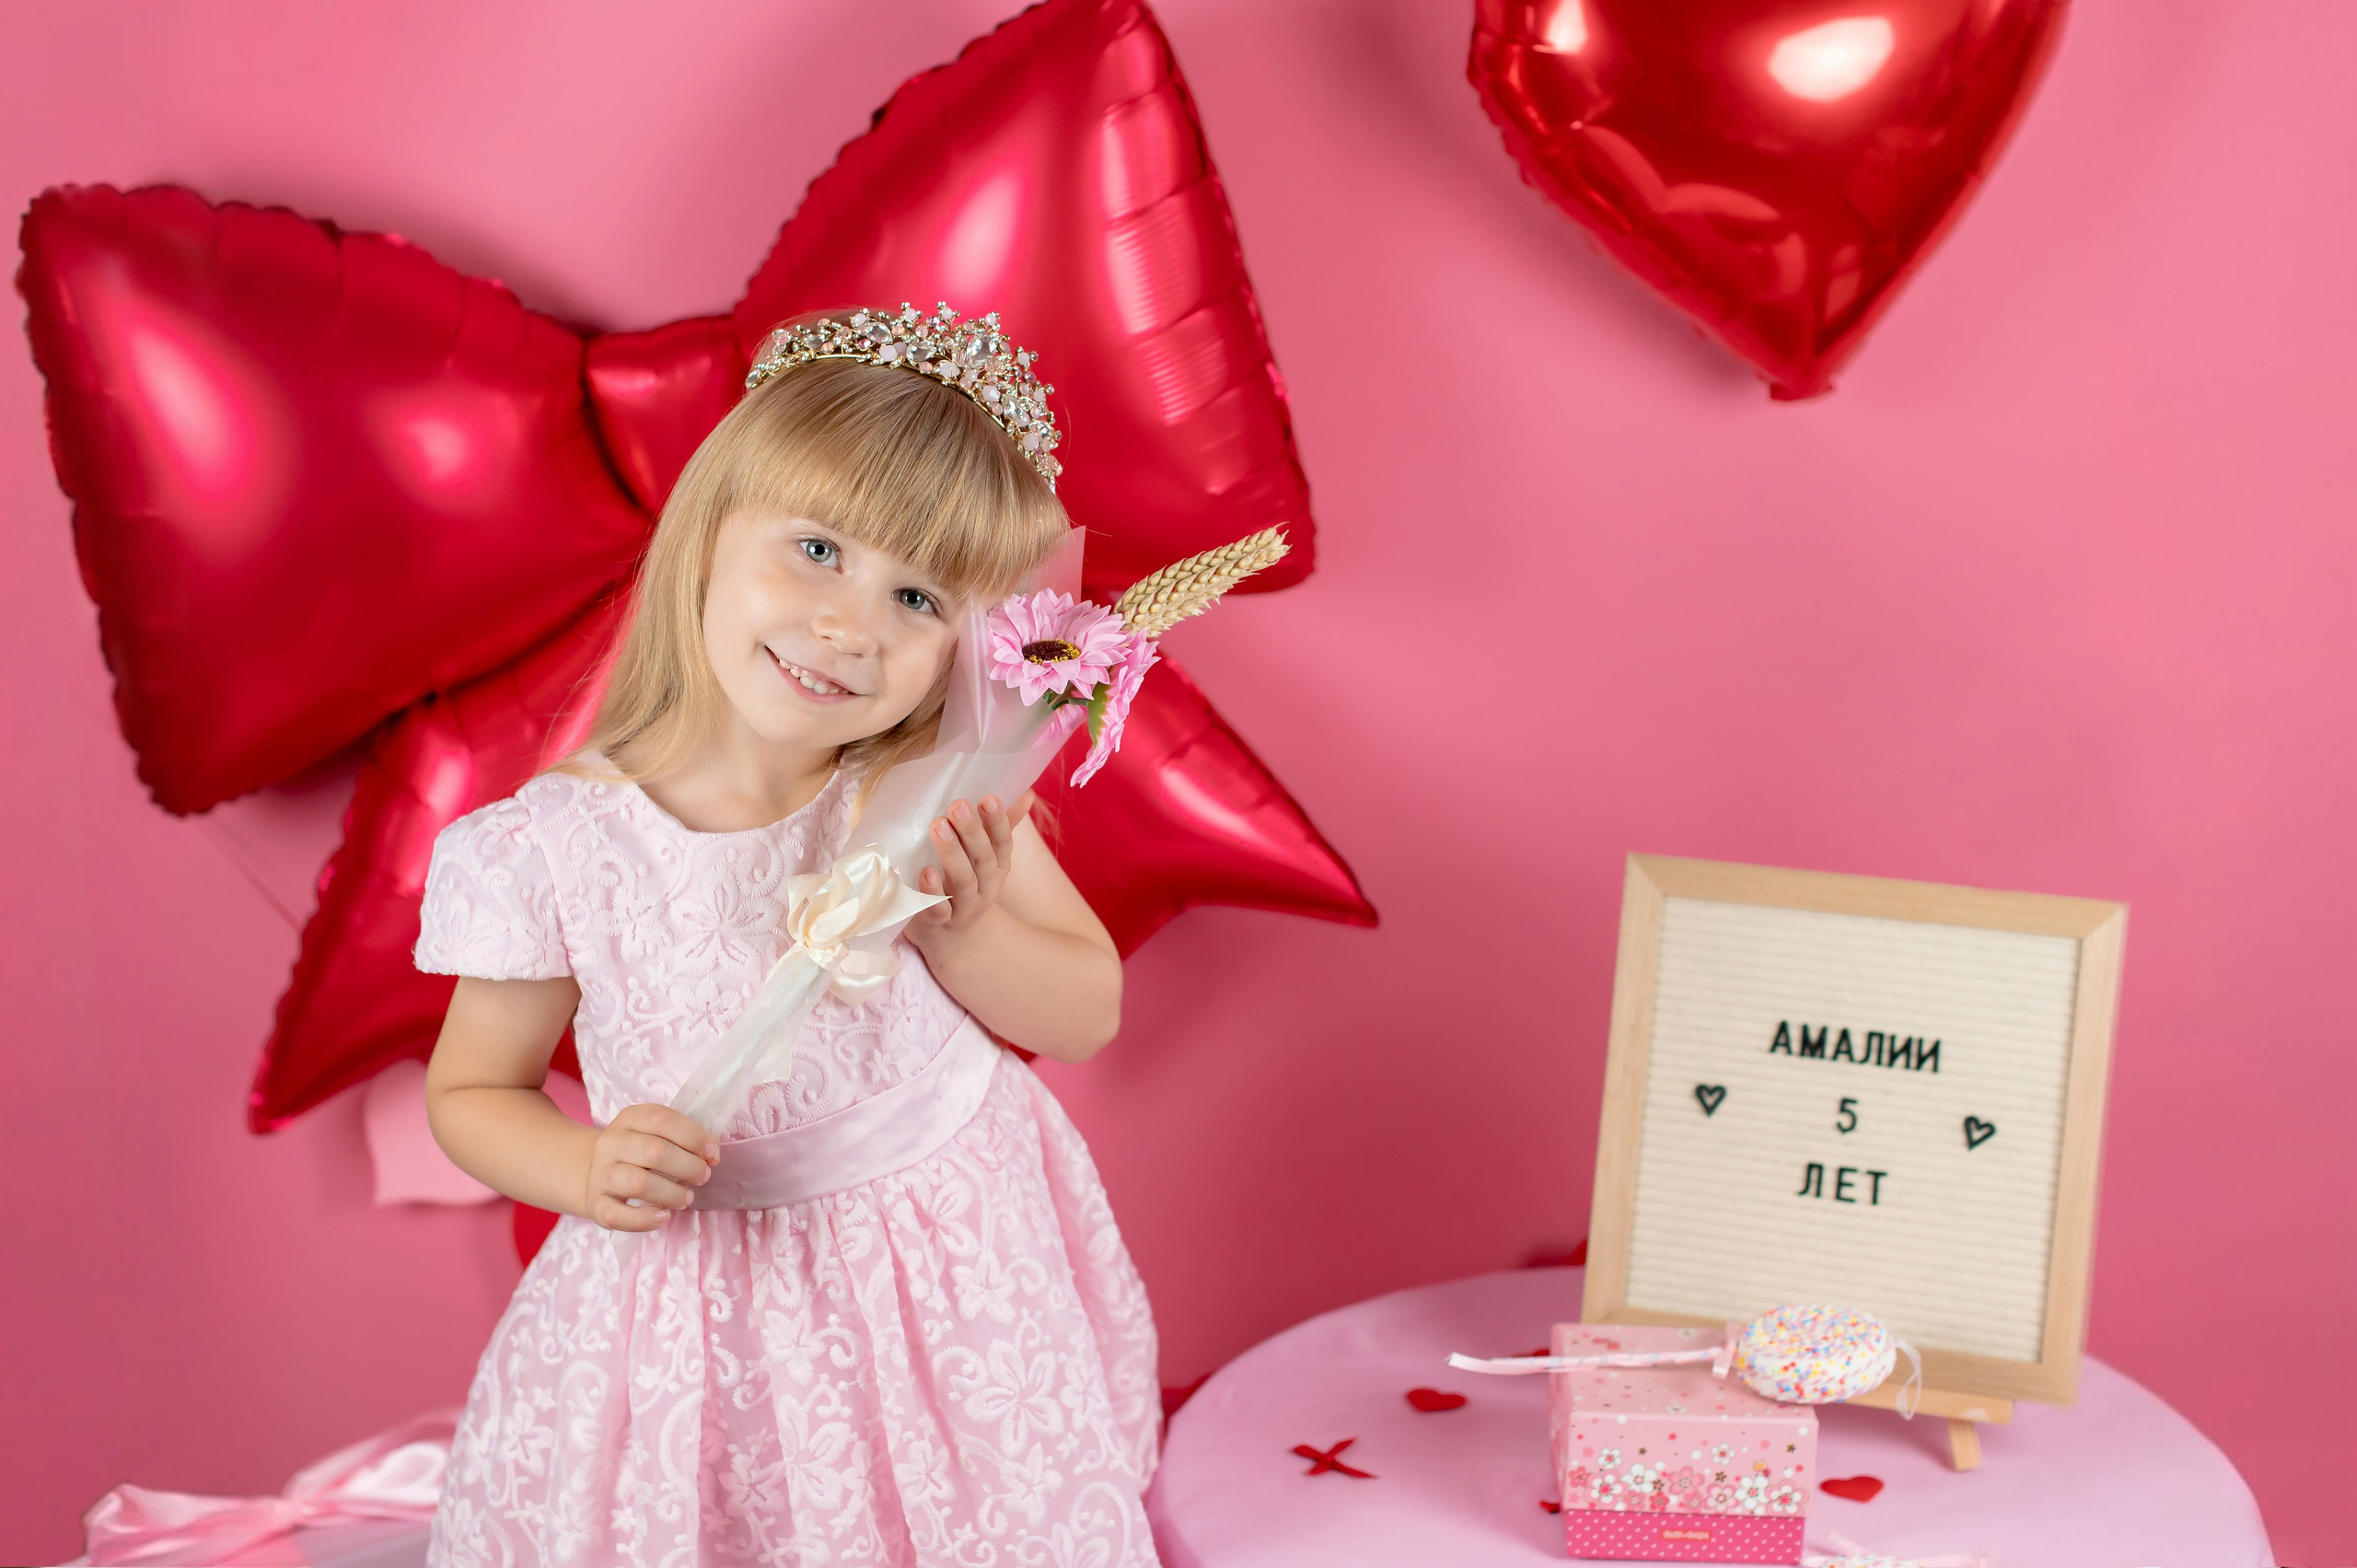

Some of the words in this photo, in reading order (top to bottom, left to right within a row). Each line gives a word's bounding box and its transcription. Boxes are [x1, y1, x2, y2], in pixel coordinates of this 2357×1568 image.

[1769, 1020, 1941, 1074] АМАЛИИ
[1836, 1098, 1858, 1133] 5
[1798, 1162, 1887, 1205] ЛЕТ
